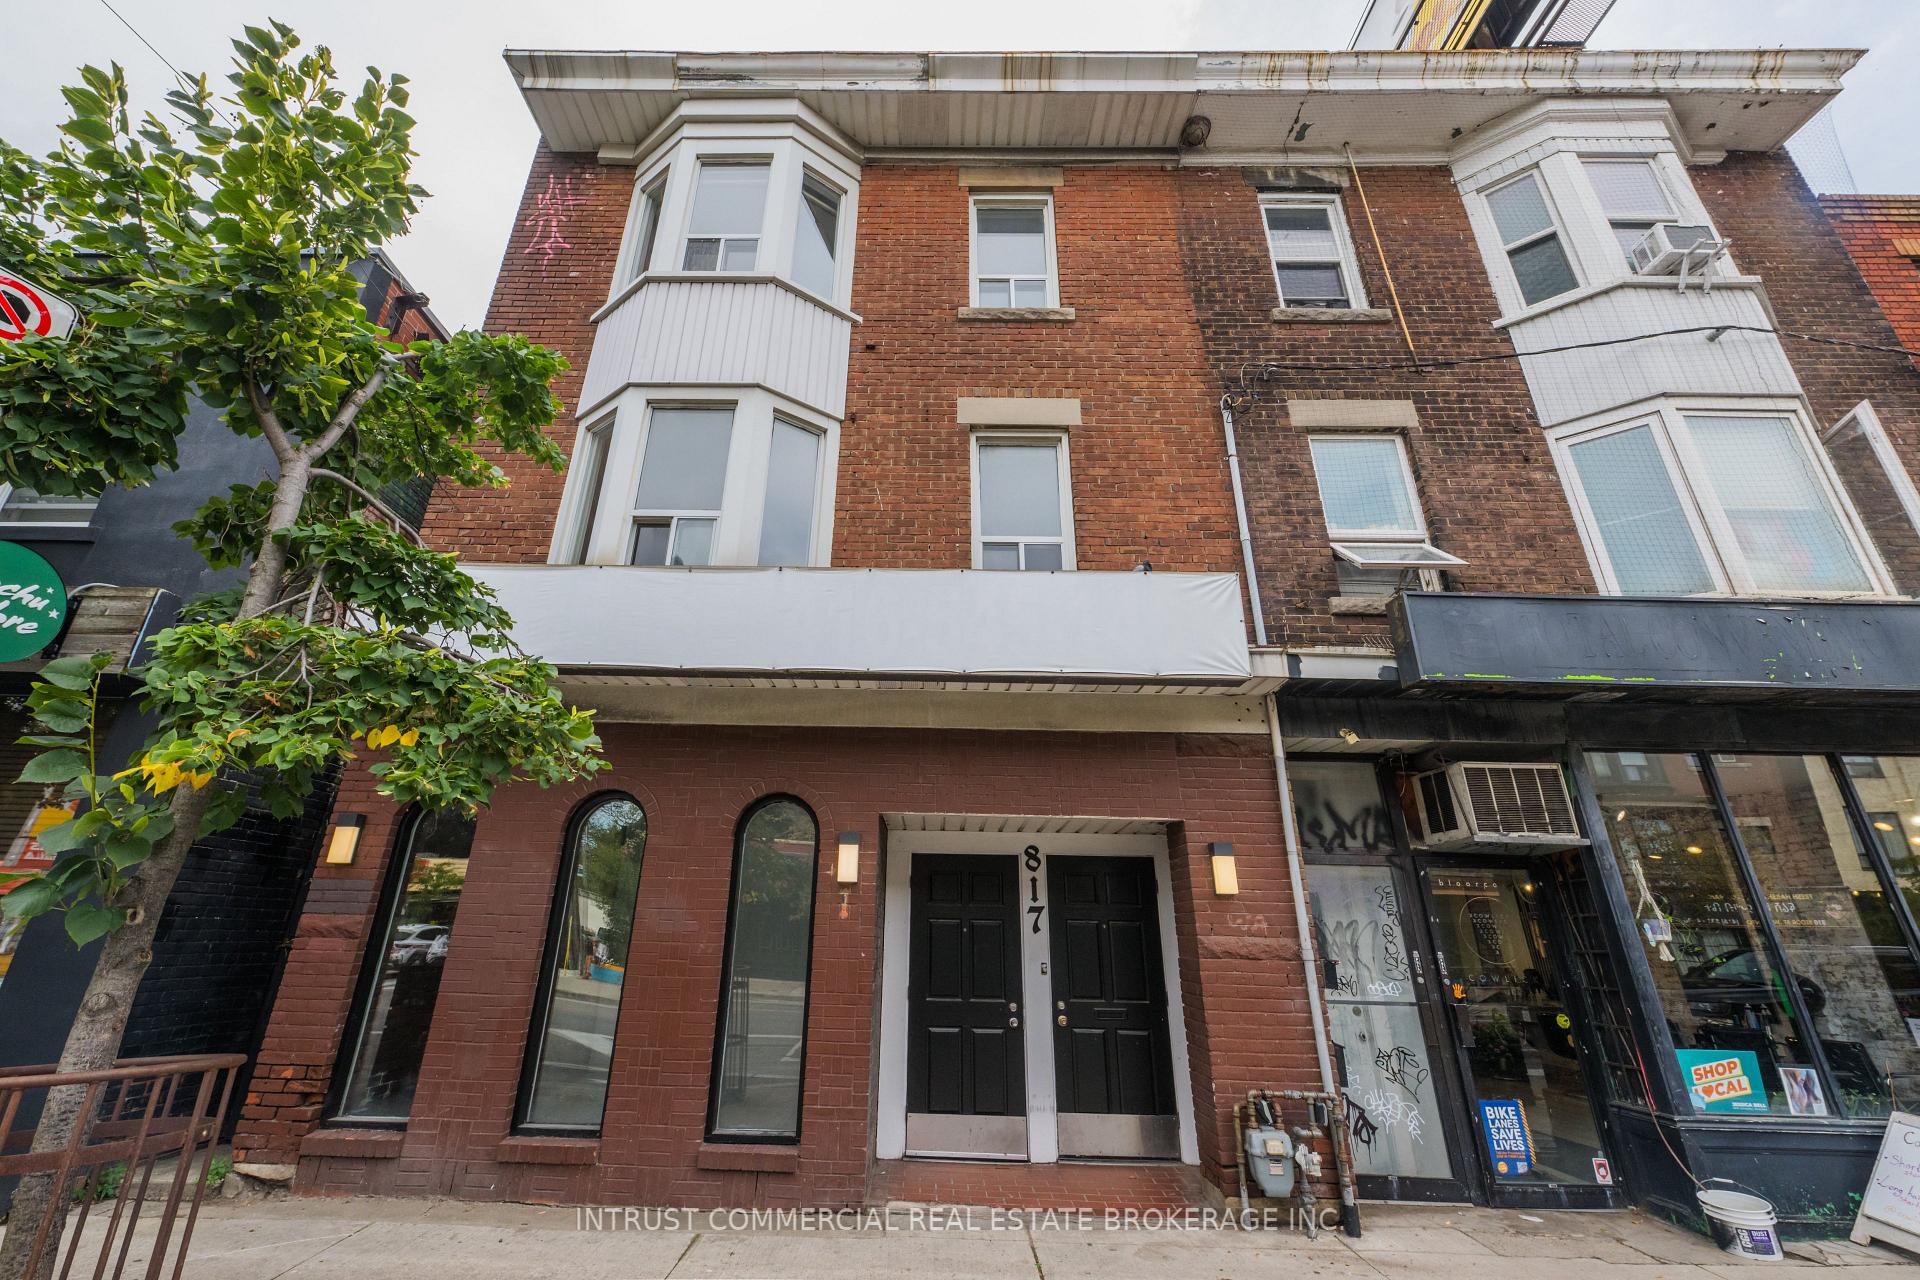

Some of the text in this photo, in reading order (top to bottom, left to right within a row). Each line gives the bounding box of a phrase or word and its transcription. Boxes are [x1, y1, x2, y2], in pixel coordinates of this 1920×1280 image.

[1023, 844, 1046, 935] 817
[1693, 1060, 1738, 1082] SHOP
[1485, 1106, 1518, 1120] BIKE
[1488, 1119, 1520, 1129] LANES
[1491, 1128, 1523, 1140] SAVE
[1493, 1139, 1525, 1151] LIVES
